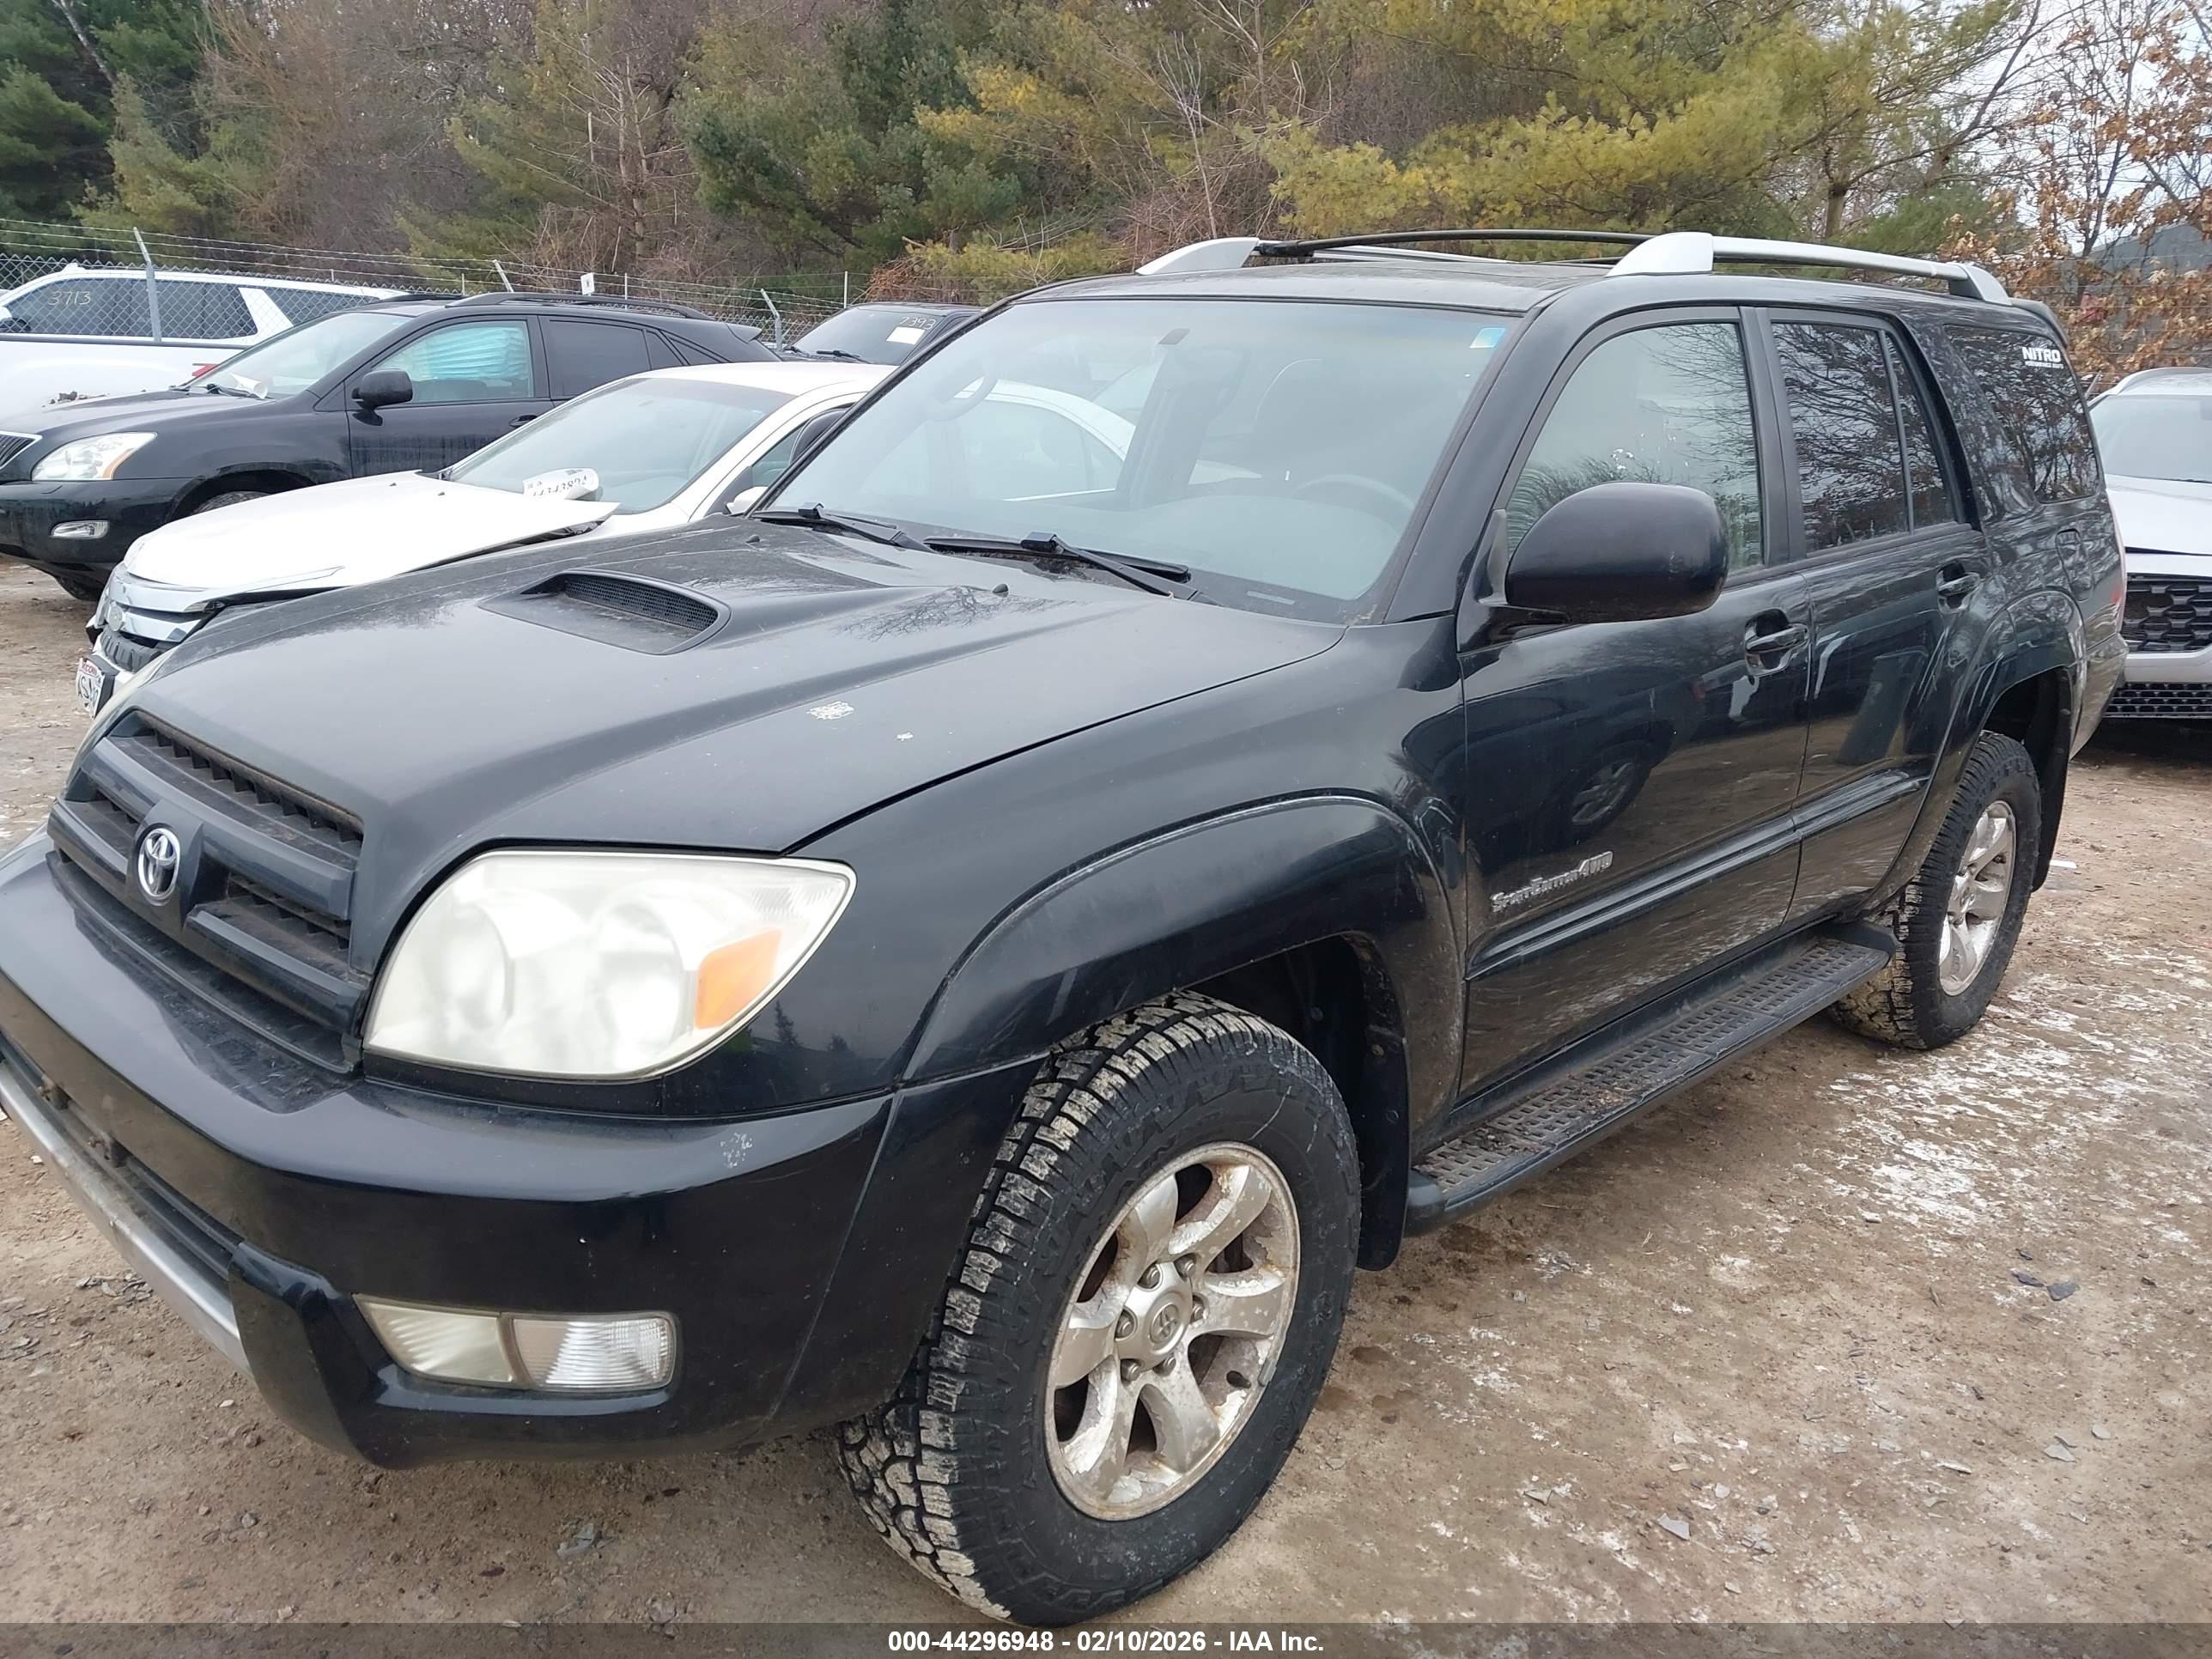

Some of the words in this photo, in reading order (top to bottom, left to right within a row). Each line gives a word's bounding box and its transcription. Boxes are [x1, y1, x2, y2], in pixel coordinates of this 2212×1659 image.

[48, 291, 91, 305] 3713
[900, 316, 936, 330] 7393
[2022, 347, 2061, 362] NITRO
